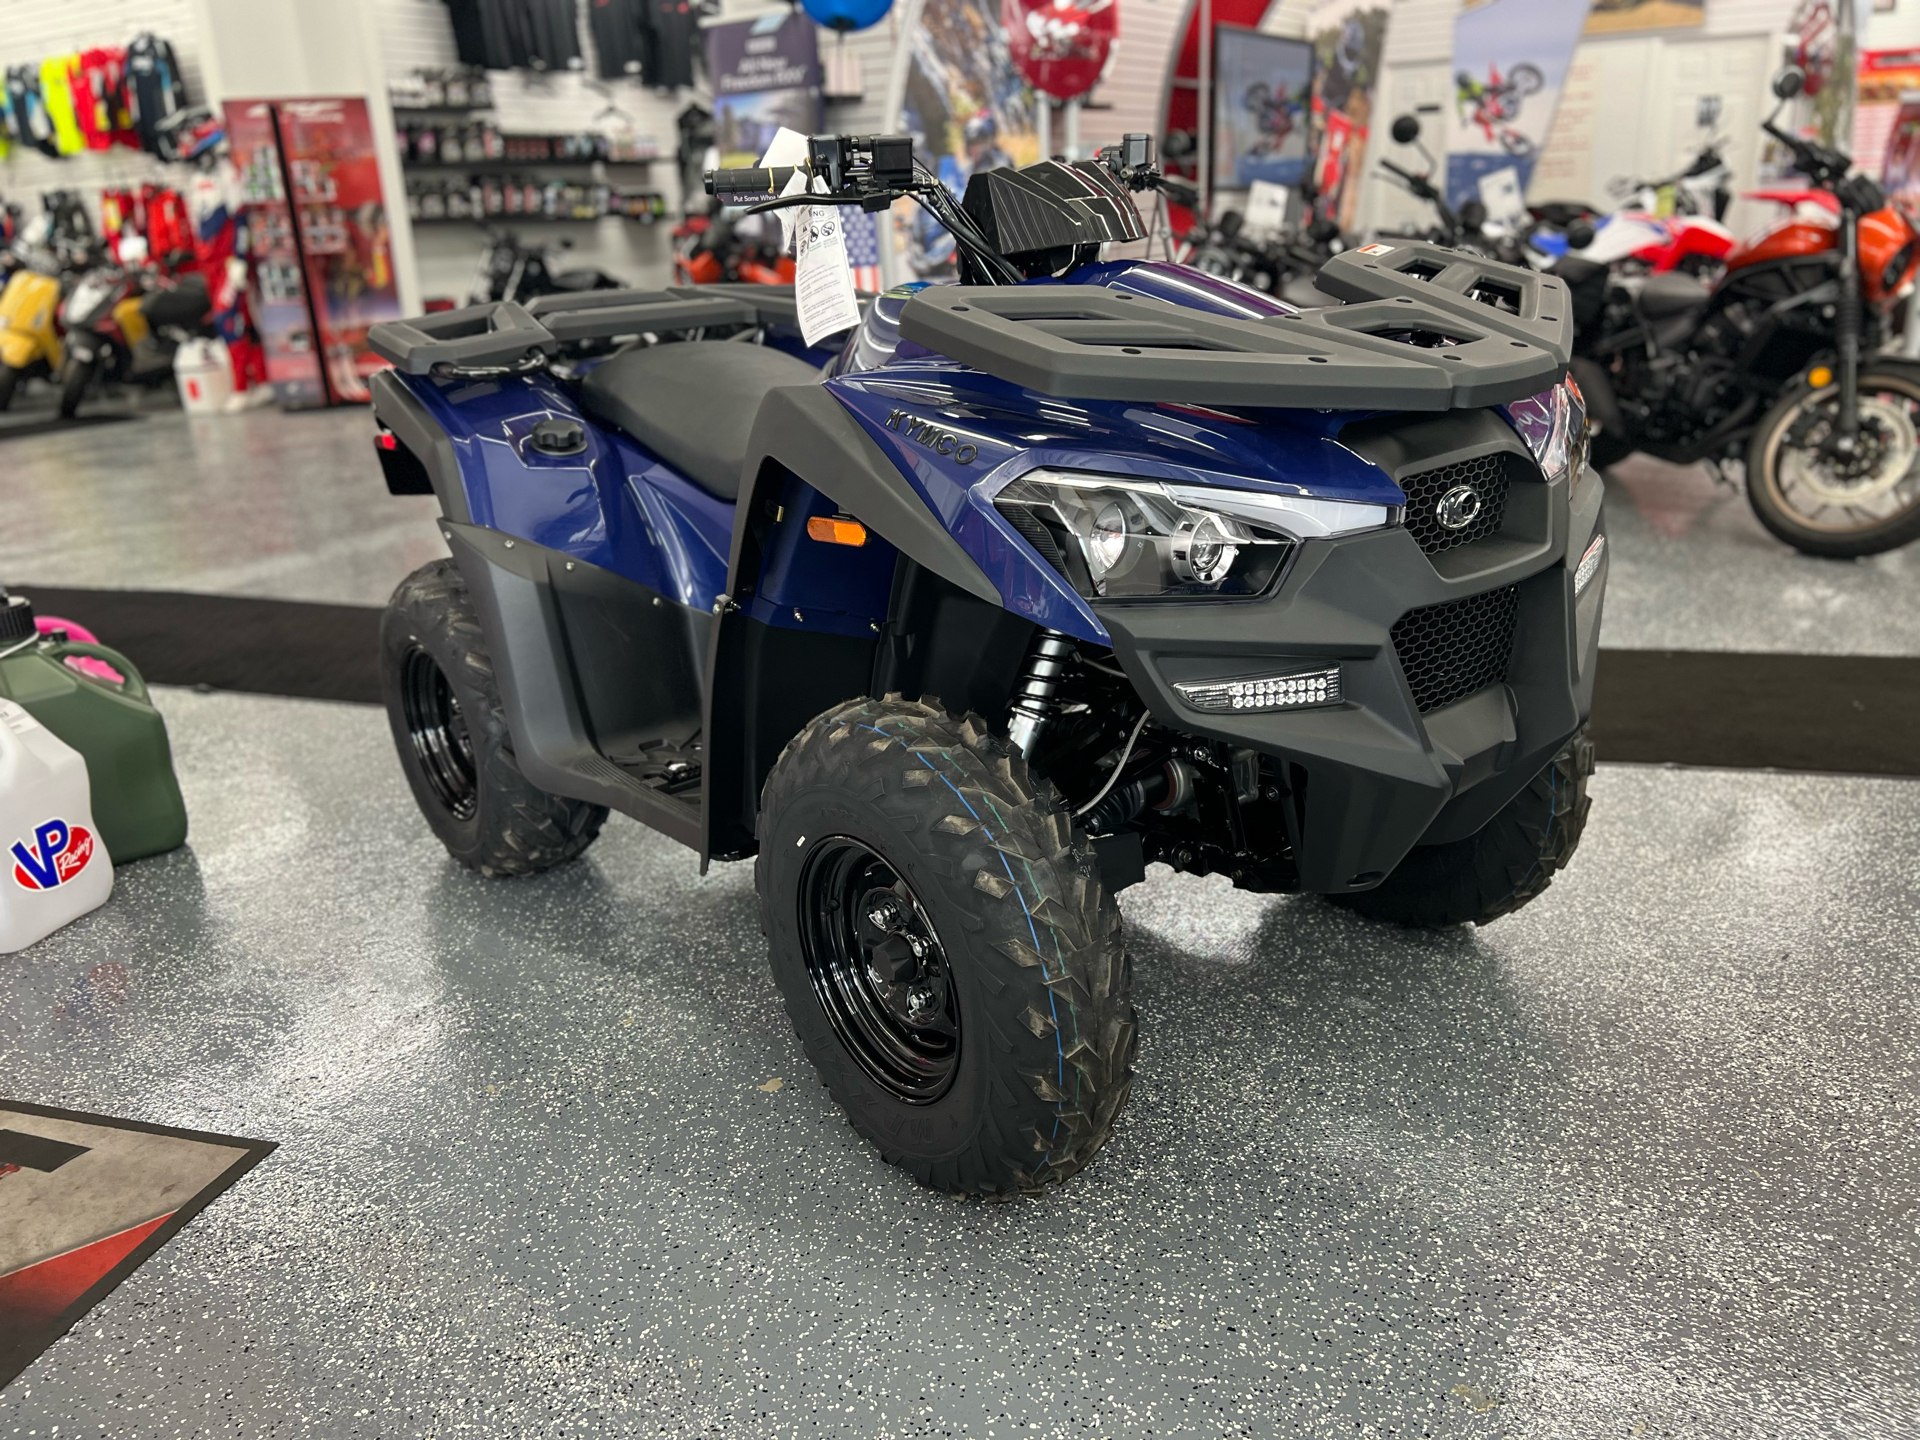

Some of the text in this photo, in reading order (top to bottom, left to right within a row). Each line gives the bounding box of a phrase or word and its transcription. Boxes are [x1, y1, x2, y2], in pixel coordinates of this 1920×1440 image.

[744, 194, 759, 202] Some
[884, 408, 978, 465] KYMCO
[10, 819, 69, 889] VP
[59, 836, 92, 877] Racing
